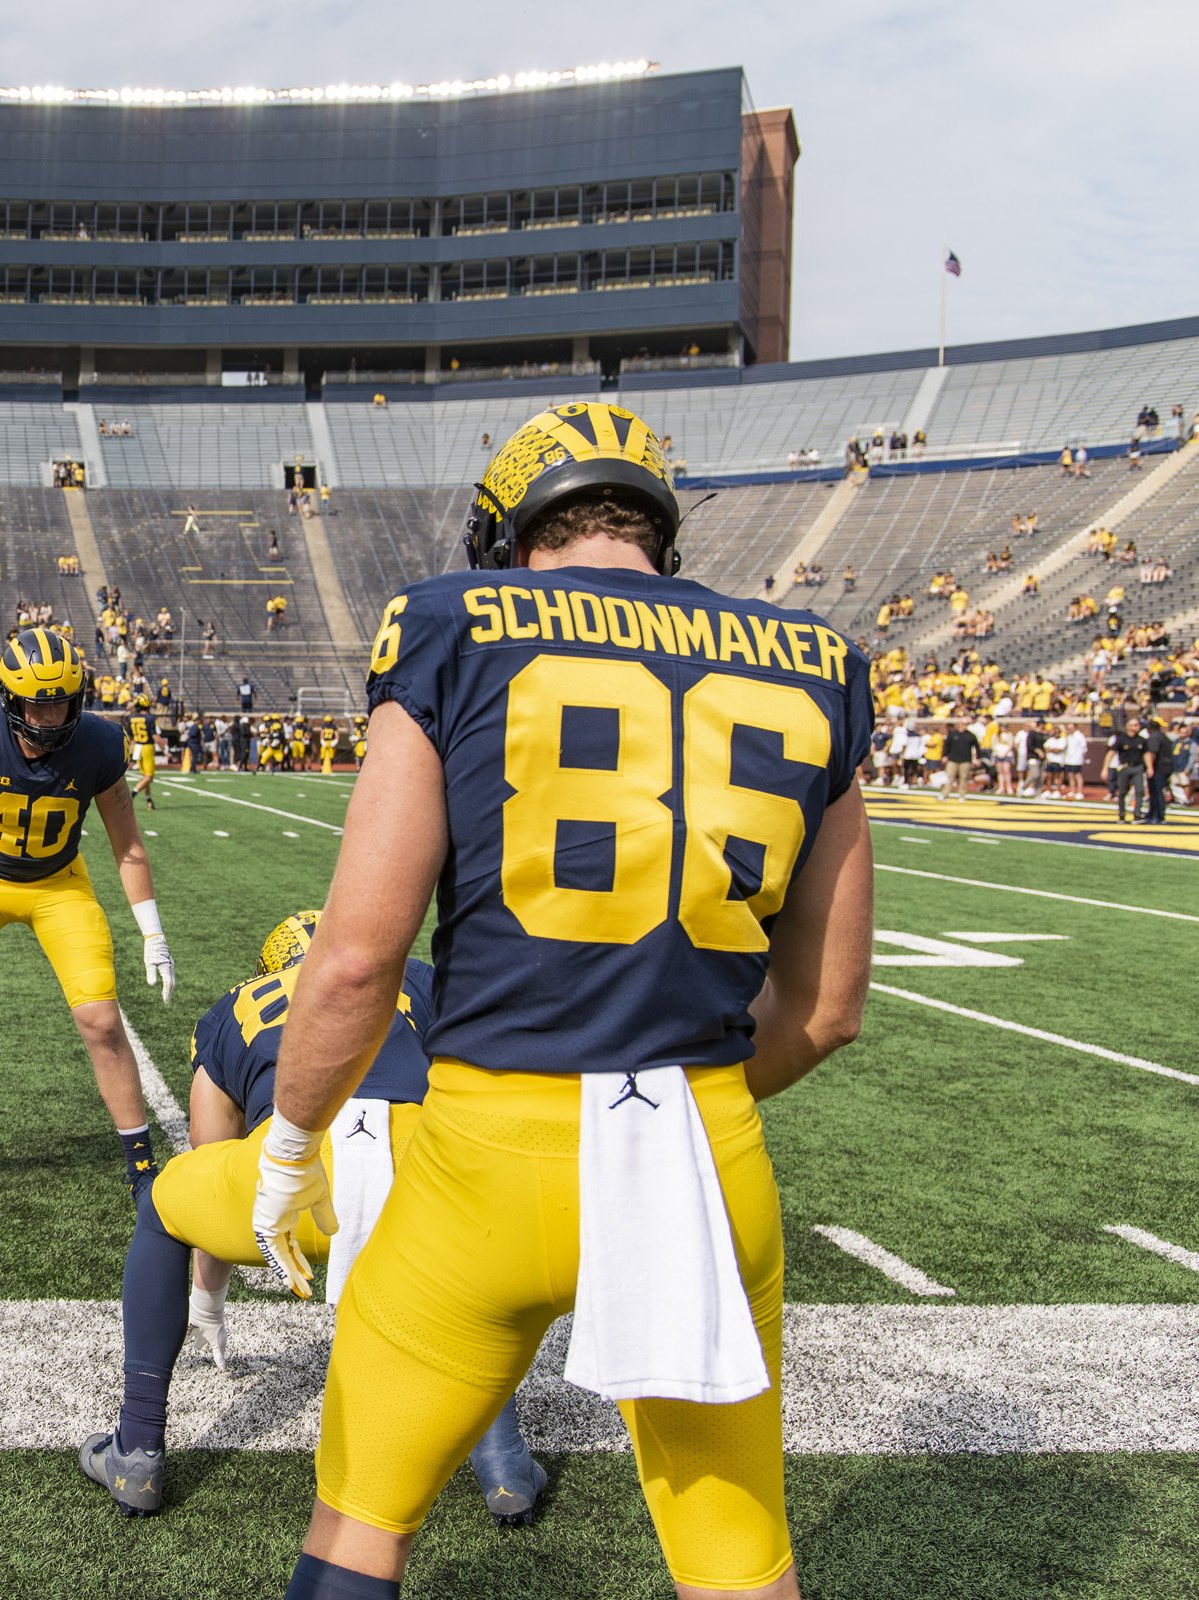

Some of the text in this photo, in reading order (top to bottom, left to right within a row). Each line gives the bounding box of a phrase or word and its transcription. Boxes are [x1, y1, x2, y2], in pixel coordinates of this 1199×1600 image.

[544, 449, 565, 465] 86
[366, 595, 409, 683] 6
[462, 586, 849, 686] SCHOONMAKER
[502, 654, 832, 953] 86
[135, 1159, 150, 1172] M
[113, 1475, 127, 1491] M
